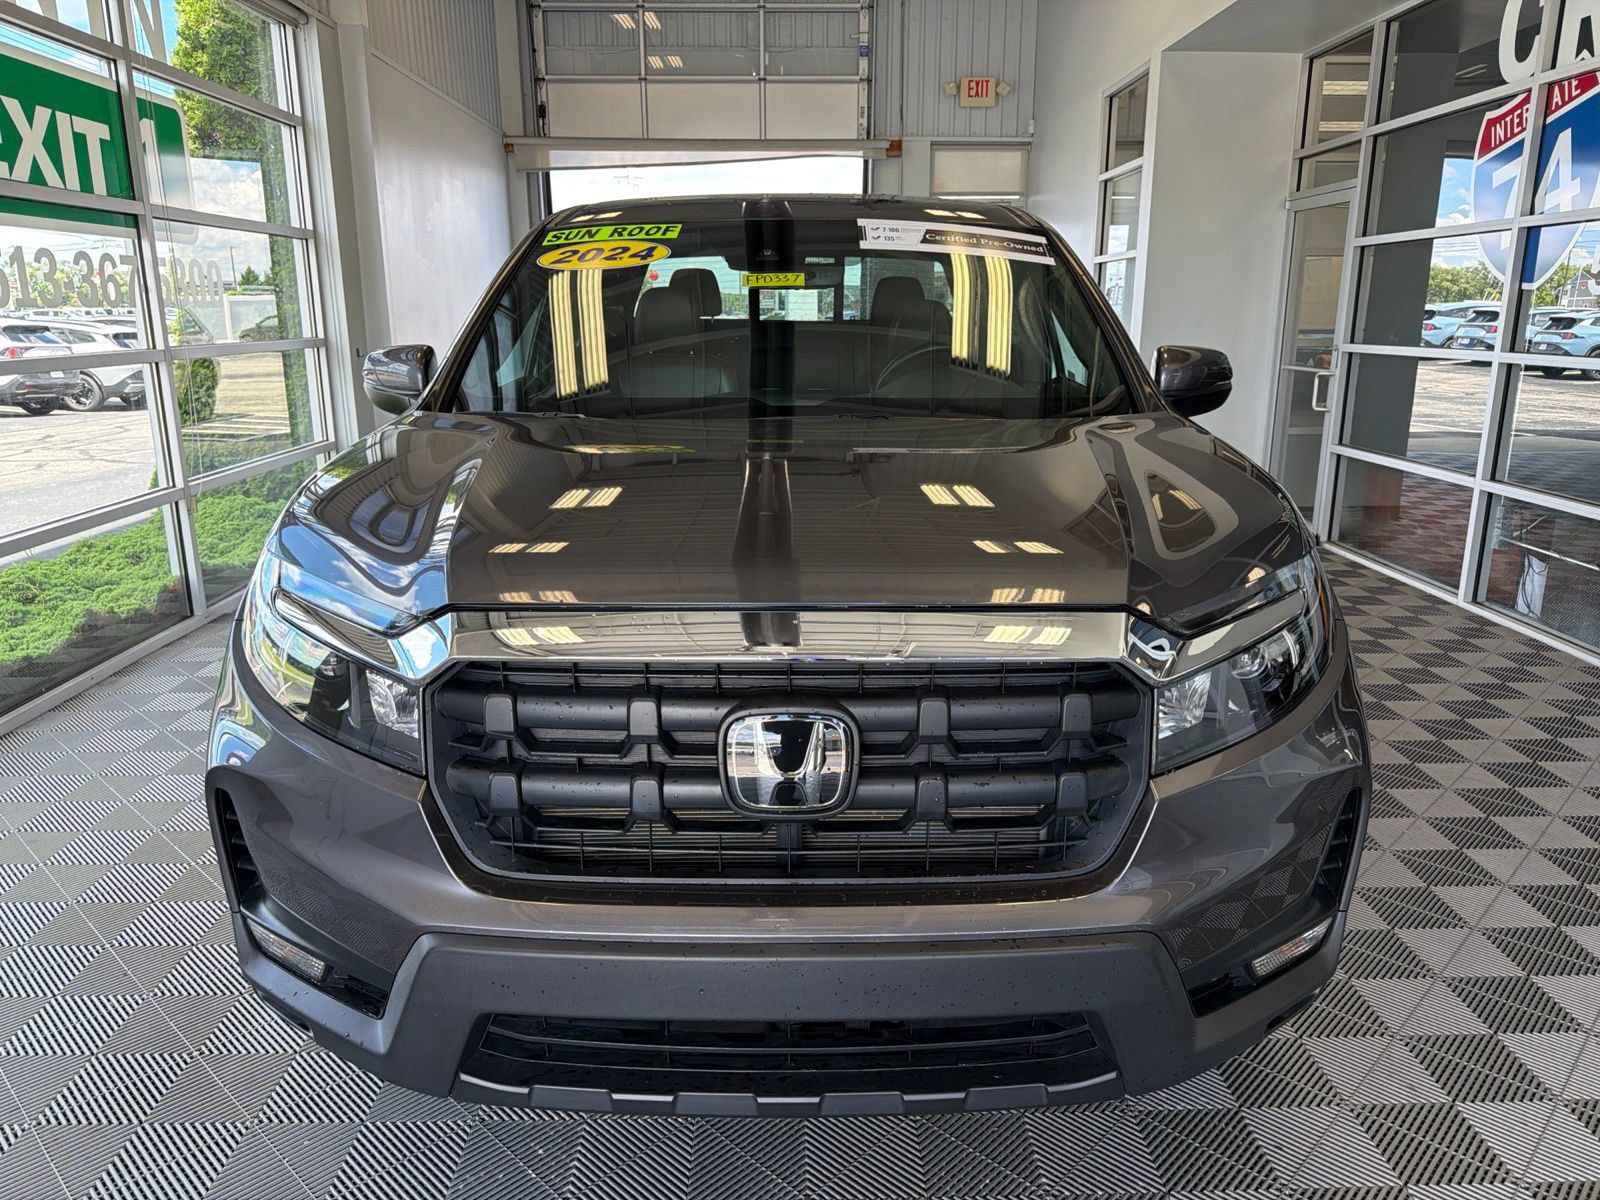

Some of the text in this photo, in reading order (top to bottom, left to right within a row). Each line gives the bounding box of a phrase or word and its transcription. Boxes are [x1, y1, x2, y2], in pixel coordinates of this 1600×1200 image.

[967, 79, 990, 98] EXIT
[0, 96, 111, 196] XIT
[547, 225, 677, 242] SUN ROOF
[925, 232, 1044, 253] Certified Pre-Owned
[549, 246, 659, 265] 2024
